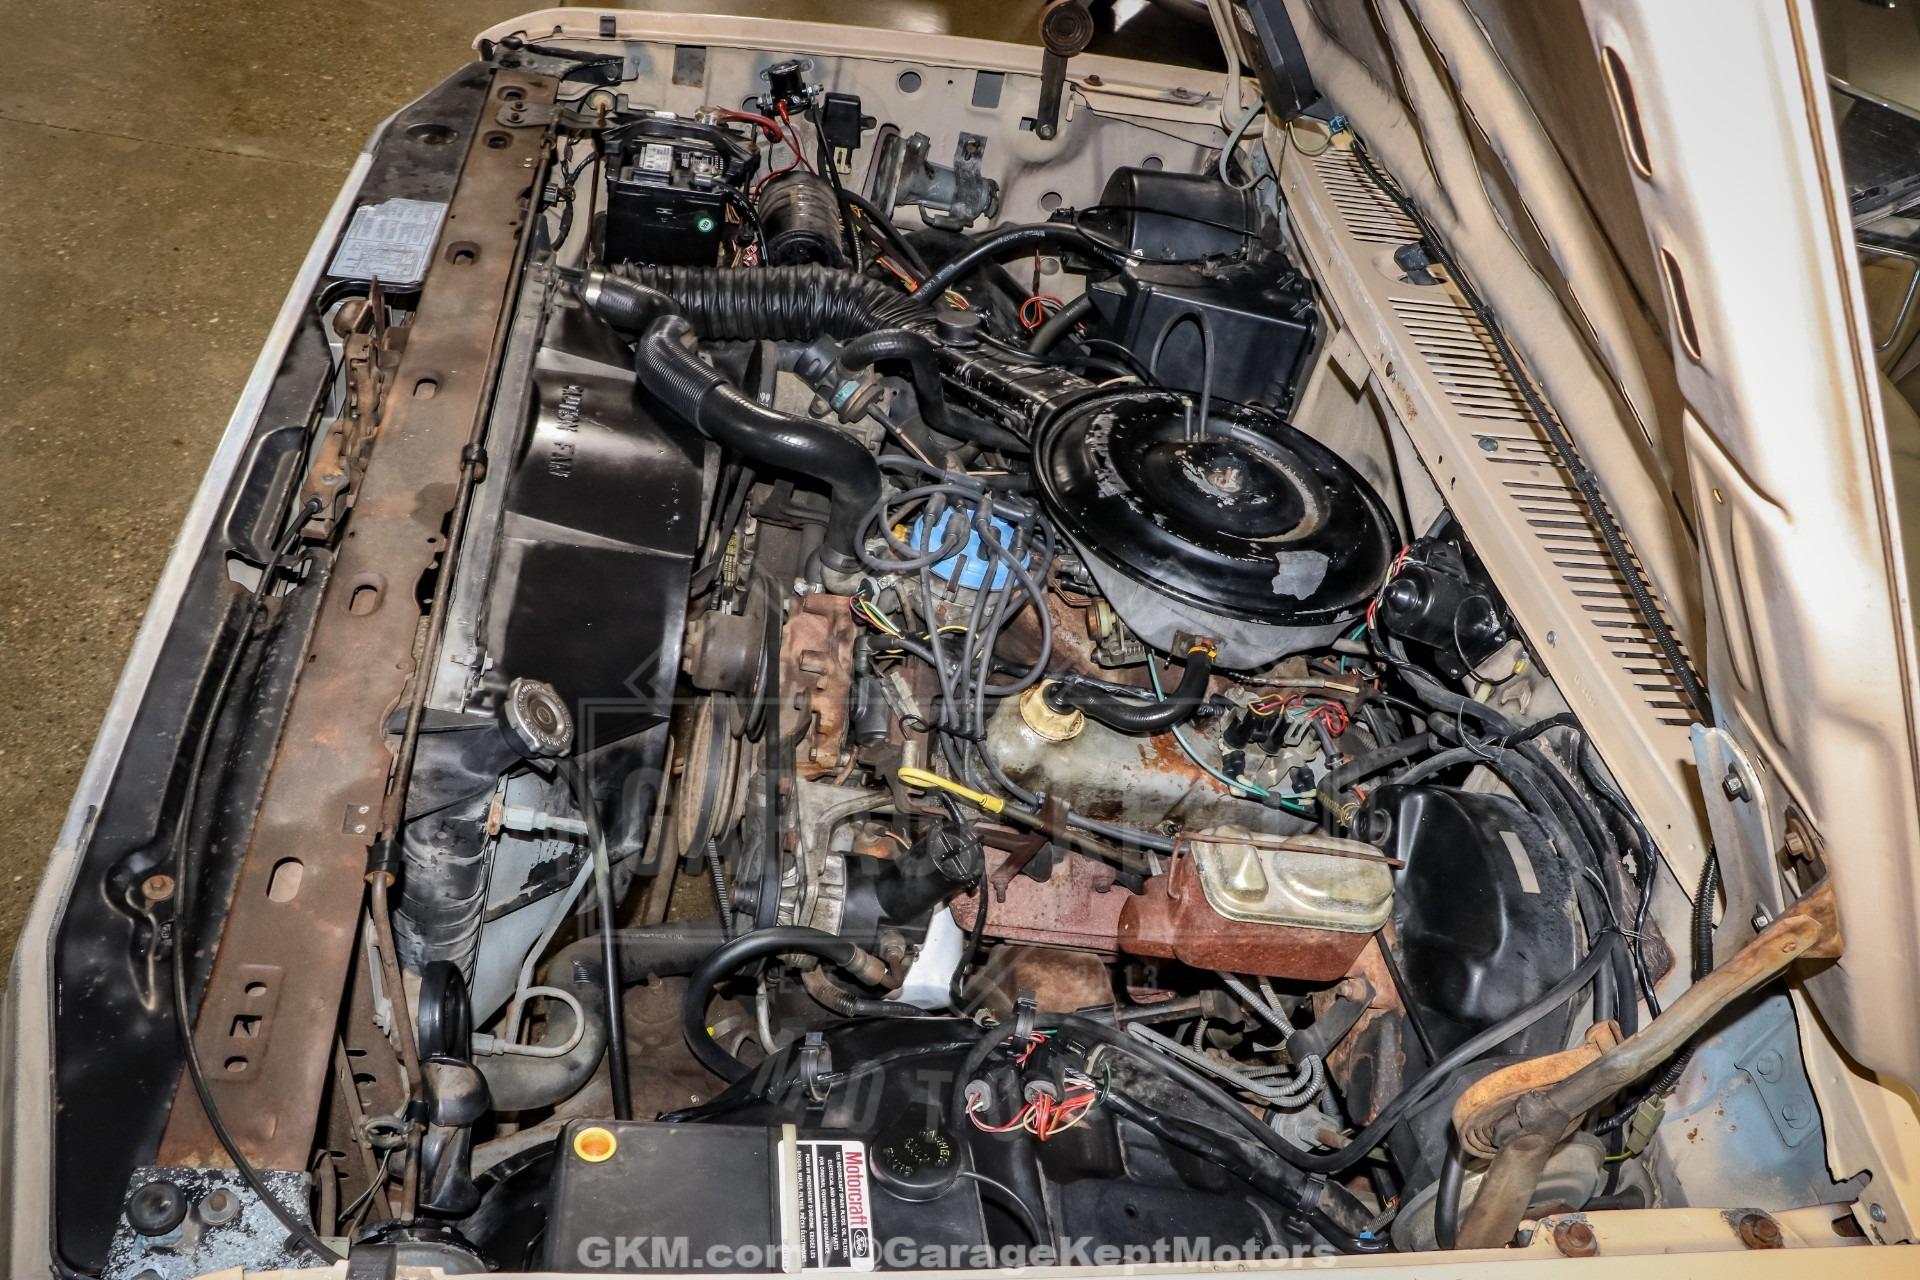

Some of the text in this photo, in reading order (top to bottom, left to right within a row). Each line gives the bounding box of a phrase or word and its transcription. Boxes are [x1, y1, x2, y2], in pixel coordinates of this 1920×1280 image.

[547, 442, 576, 478] FAN
[820, 1189, 828, 1217] EQUIPMENT
[844, 1151, 868, 1226] Motorcraft
[823, 1217, 831, 1254] PERFORMANCE
